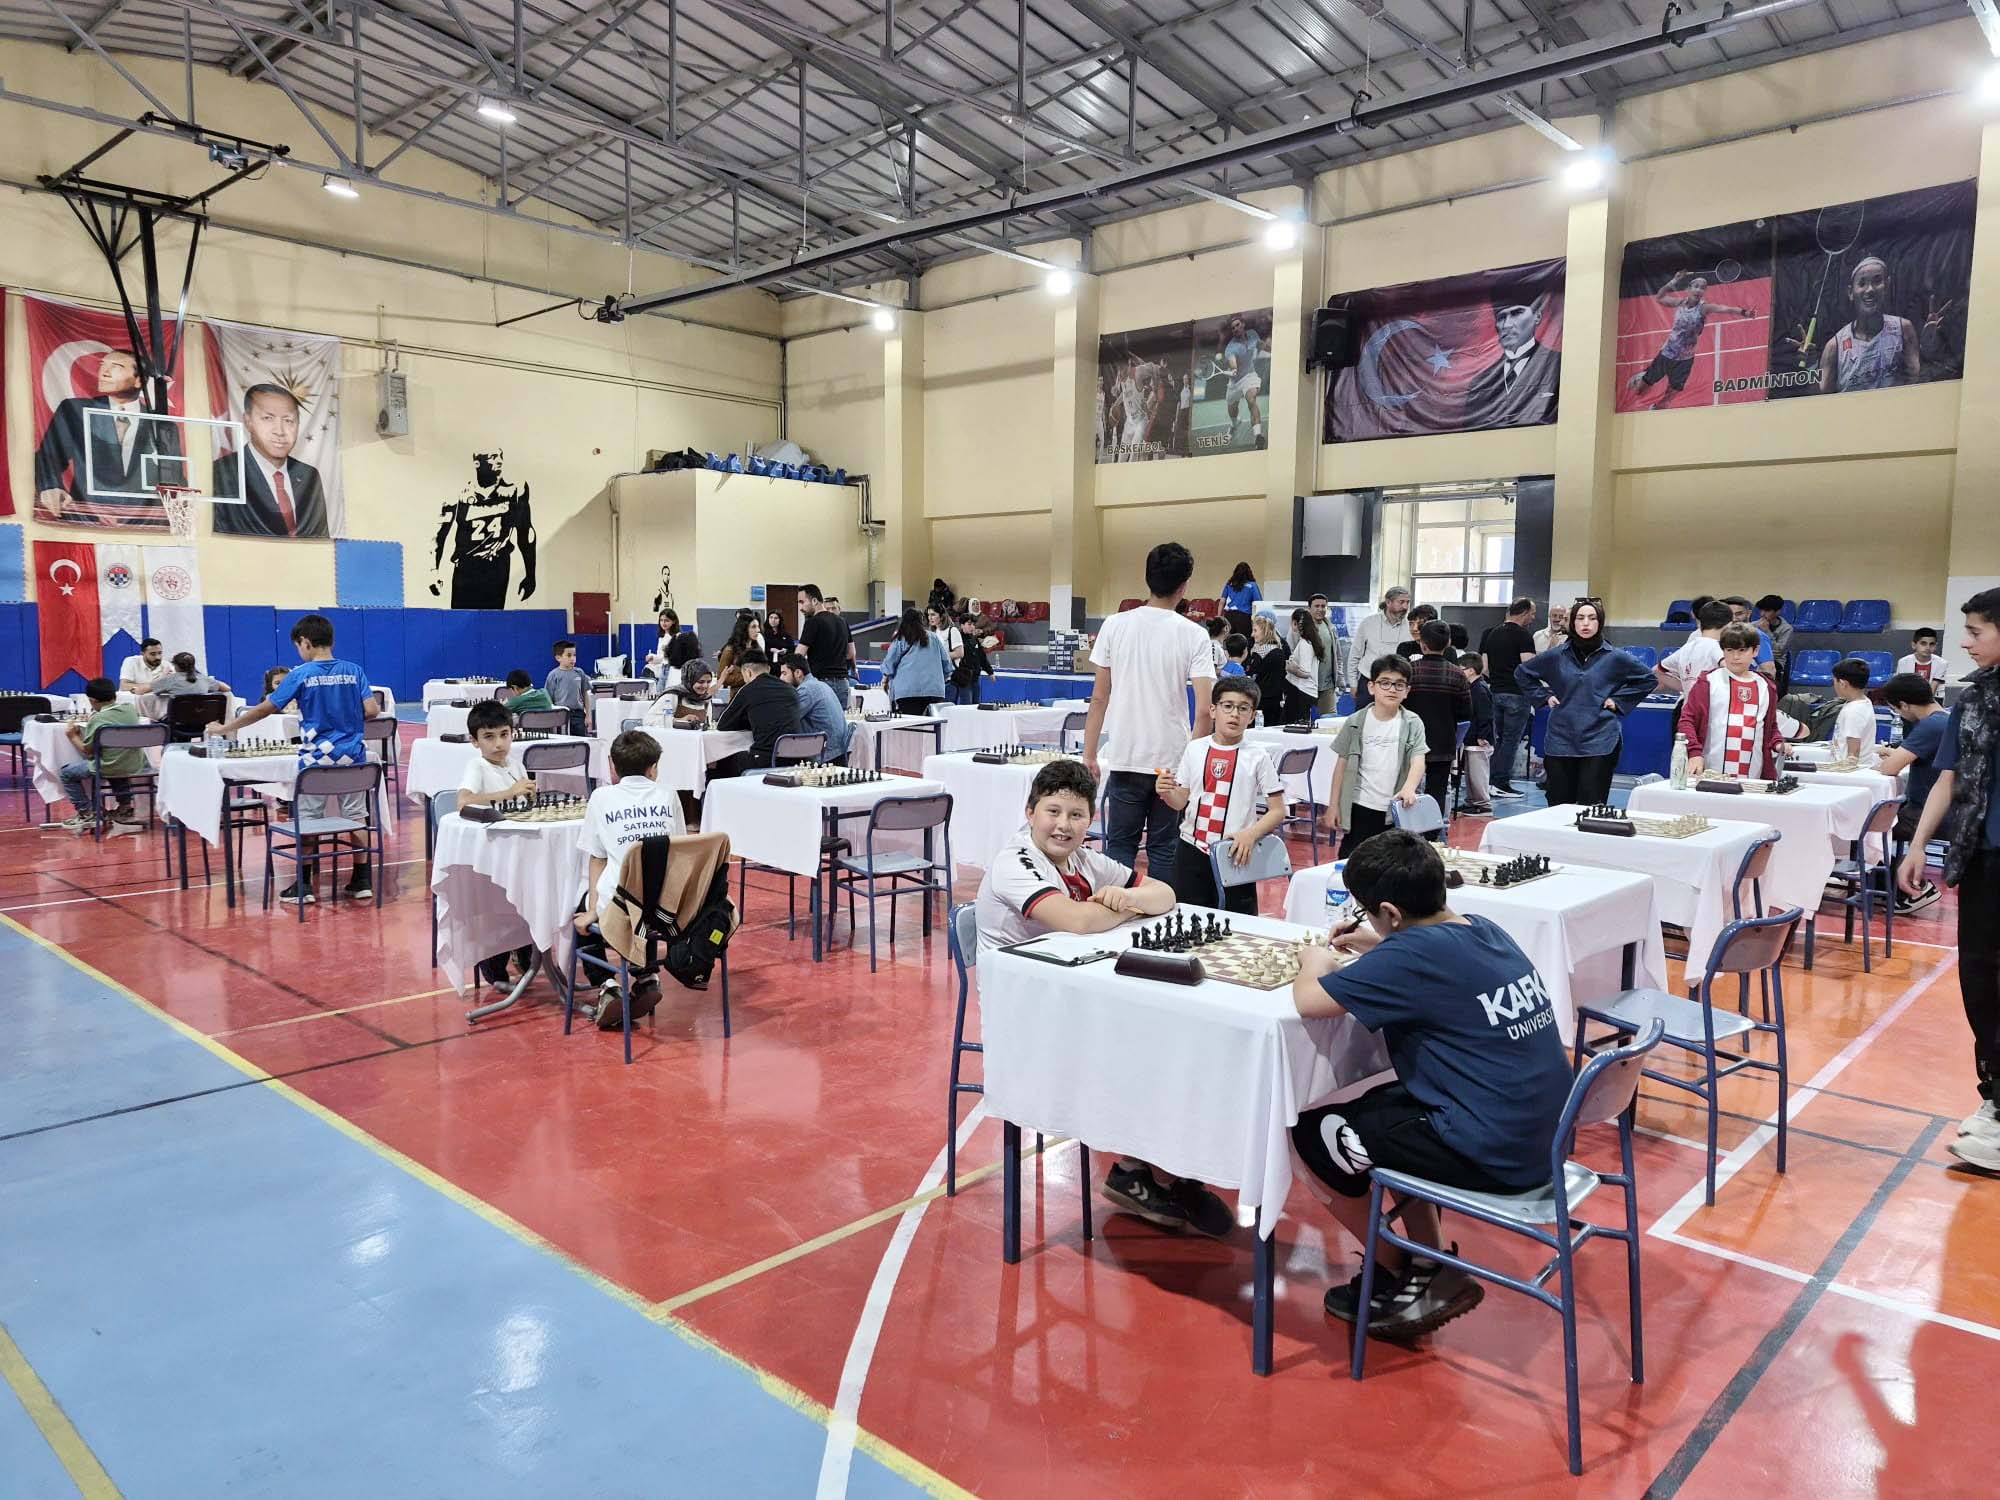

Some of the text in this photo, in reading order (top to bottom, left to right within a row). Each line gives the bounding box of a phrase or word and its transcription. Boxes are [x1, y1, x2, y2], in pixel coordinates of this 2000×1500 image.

[1713, 370, 1823, 393] BADMİNTON
[1107, 441, 1164, 455] BASKETBOL
[471, 516, 502, 541] 24
[605, 805, 647, 825] NARİN
[1476, 970, 1550, 1026] KAFK
